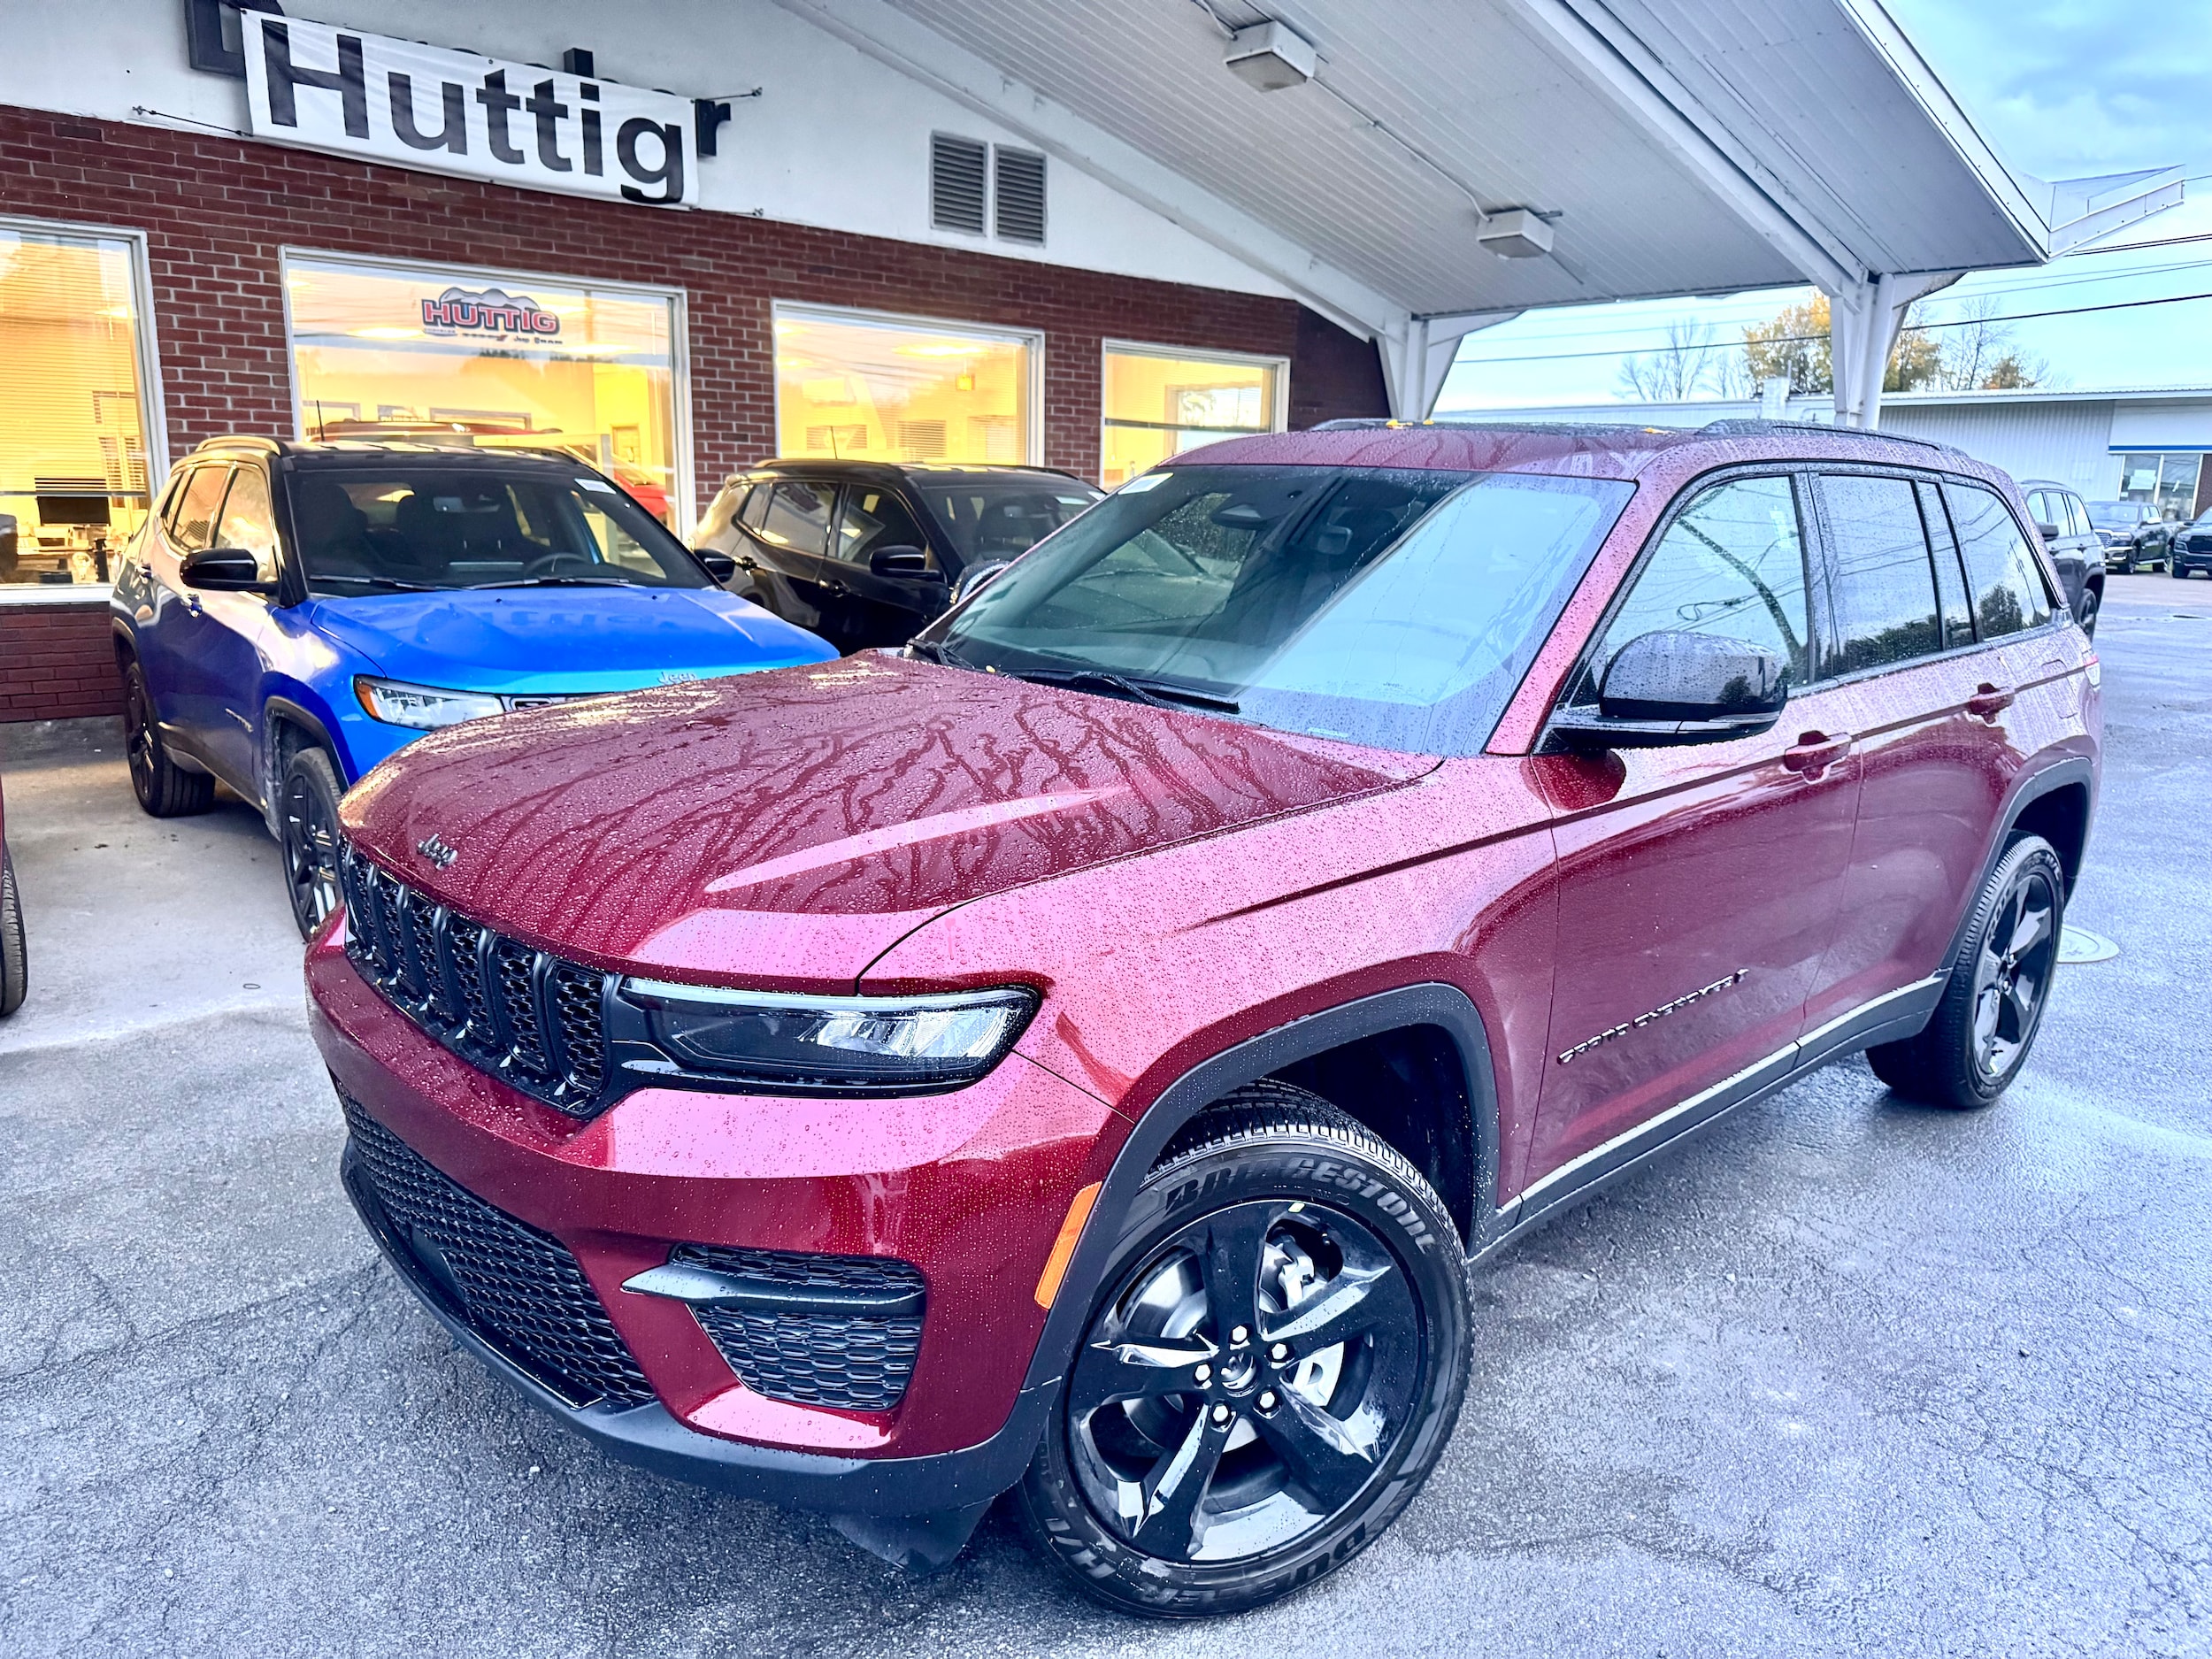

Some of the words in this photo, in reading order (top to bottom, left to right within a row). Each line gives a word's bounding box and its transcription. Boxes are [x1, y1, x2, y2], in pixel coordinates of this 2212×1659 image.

[260, 18, 684, 204] Huttig
[421, 299, 560, 335] HUTTIG
[657, 671, 697, 685] Jeep
